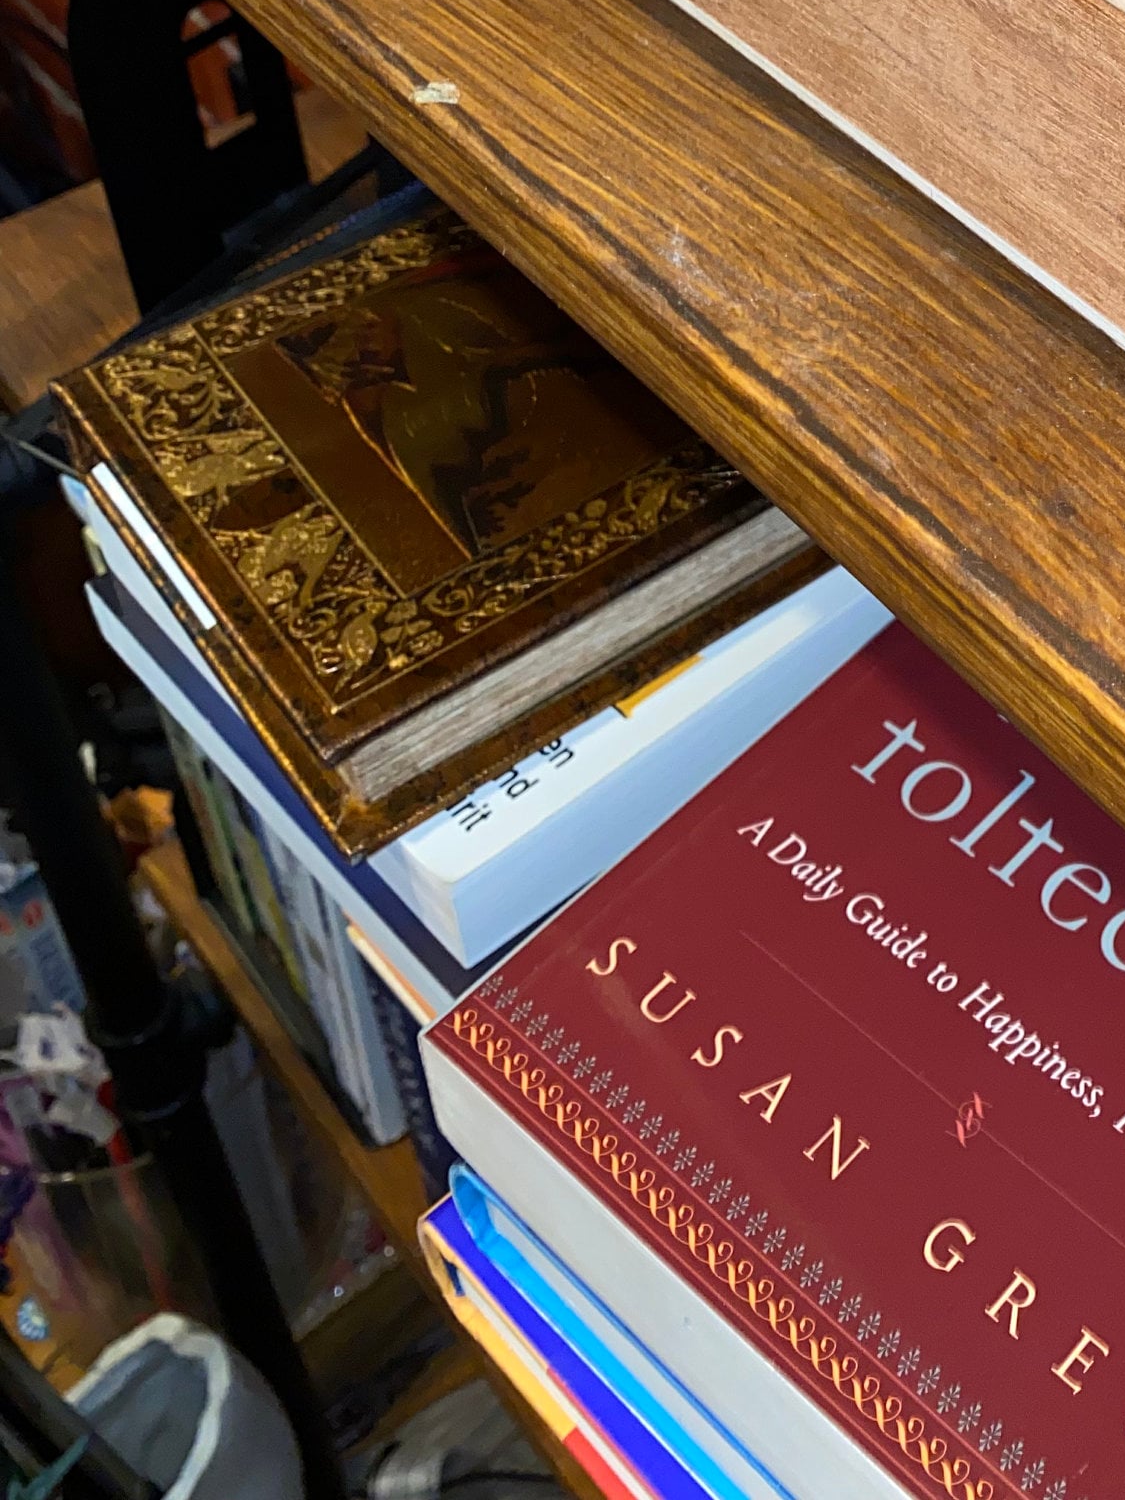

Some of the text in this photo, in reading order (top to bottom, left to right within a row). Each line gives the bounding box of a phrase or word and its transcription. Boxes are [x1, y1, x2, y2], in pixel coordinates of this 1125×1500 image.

[446, 796, 493, 832] rit
[585, 937, 871, 1182] SUSAN
[737, 816, 775, 848] A
[767, 832, 844, 902] Daily
[845, 893, 928, 970] Guide
[926, 962, 959, 994] to
[957, 981, 1104, 1120] Happiness,
